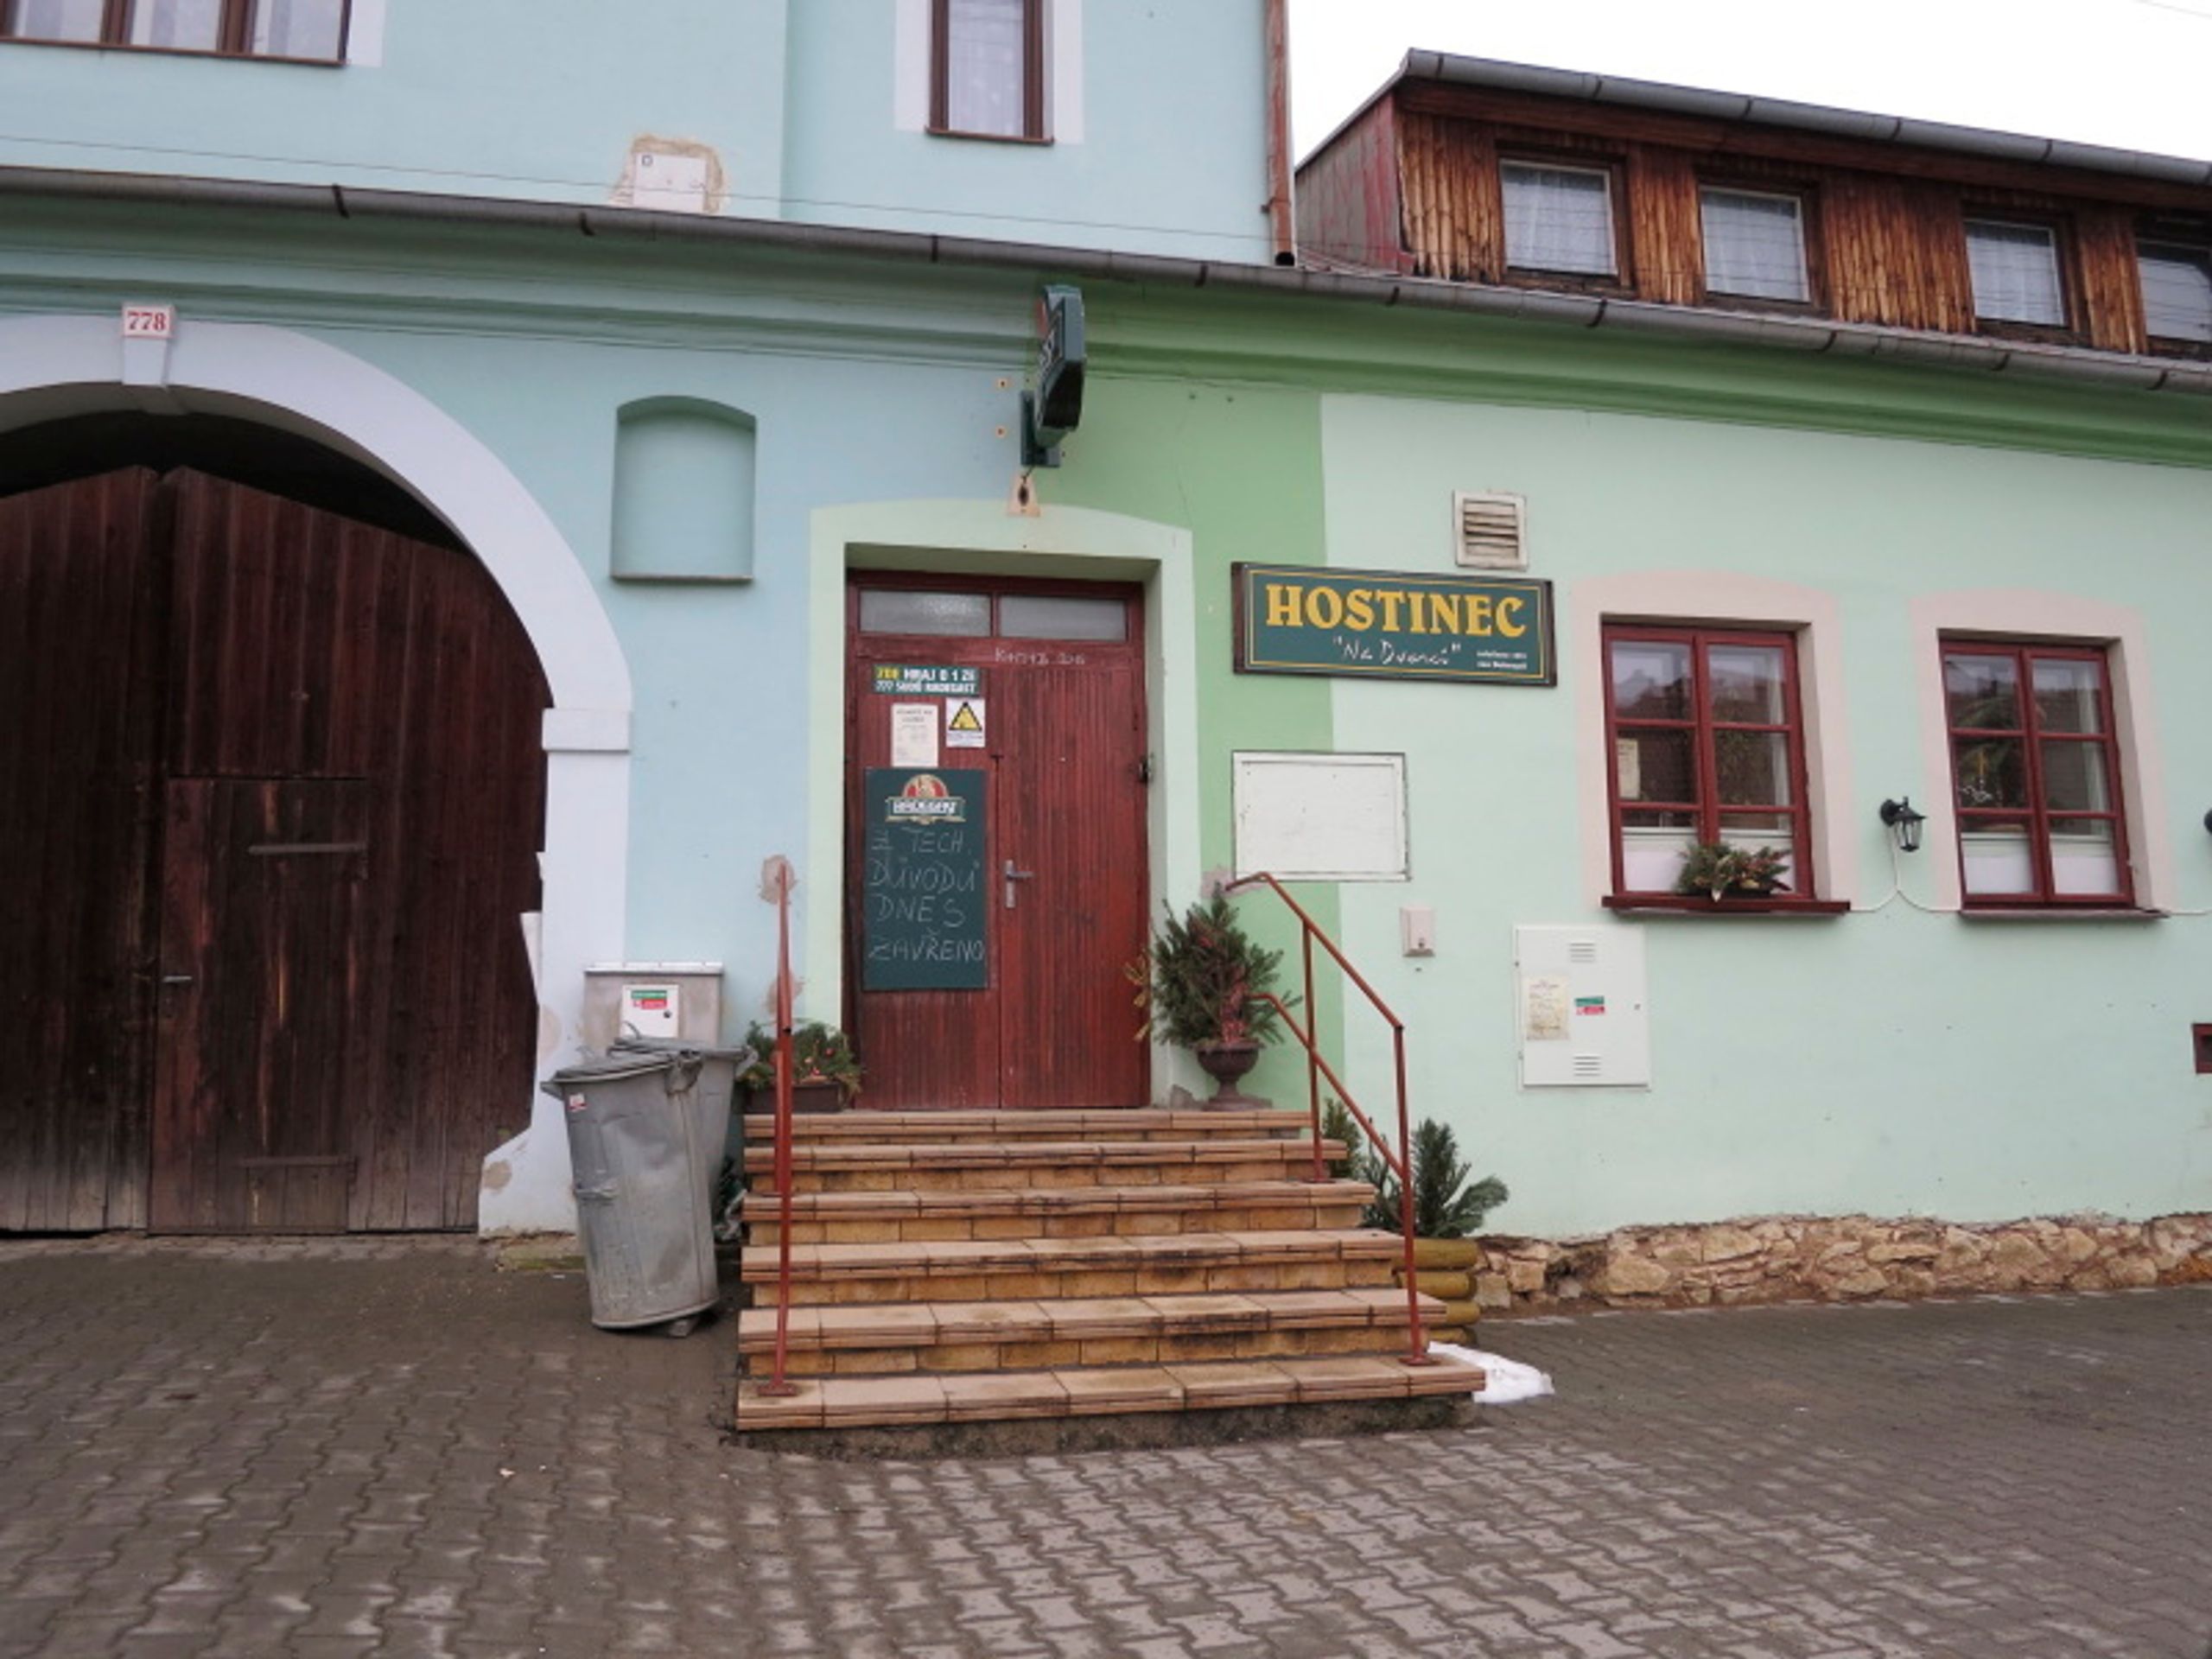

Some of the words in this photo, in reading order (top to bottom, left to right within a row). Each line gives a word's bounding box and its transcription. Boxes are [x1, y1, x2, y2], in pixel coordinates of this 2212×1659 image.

[127, 310, 166, 331] 778
[1265, 583, 1527, 639] HOSTINEC
[871, 893, 967, 929] DNES
